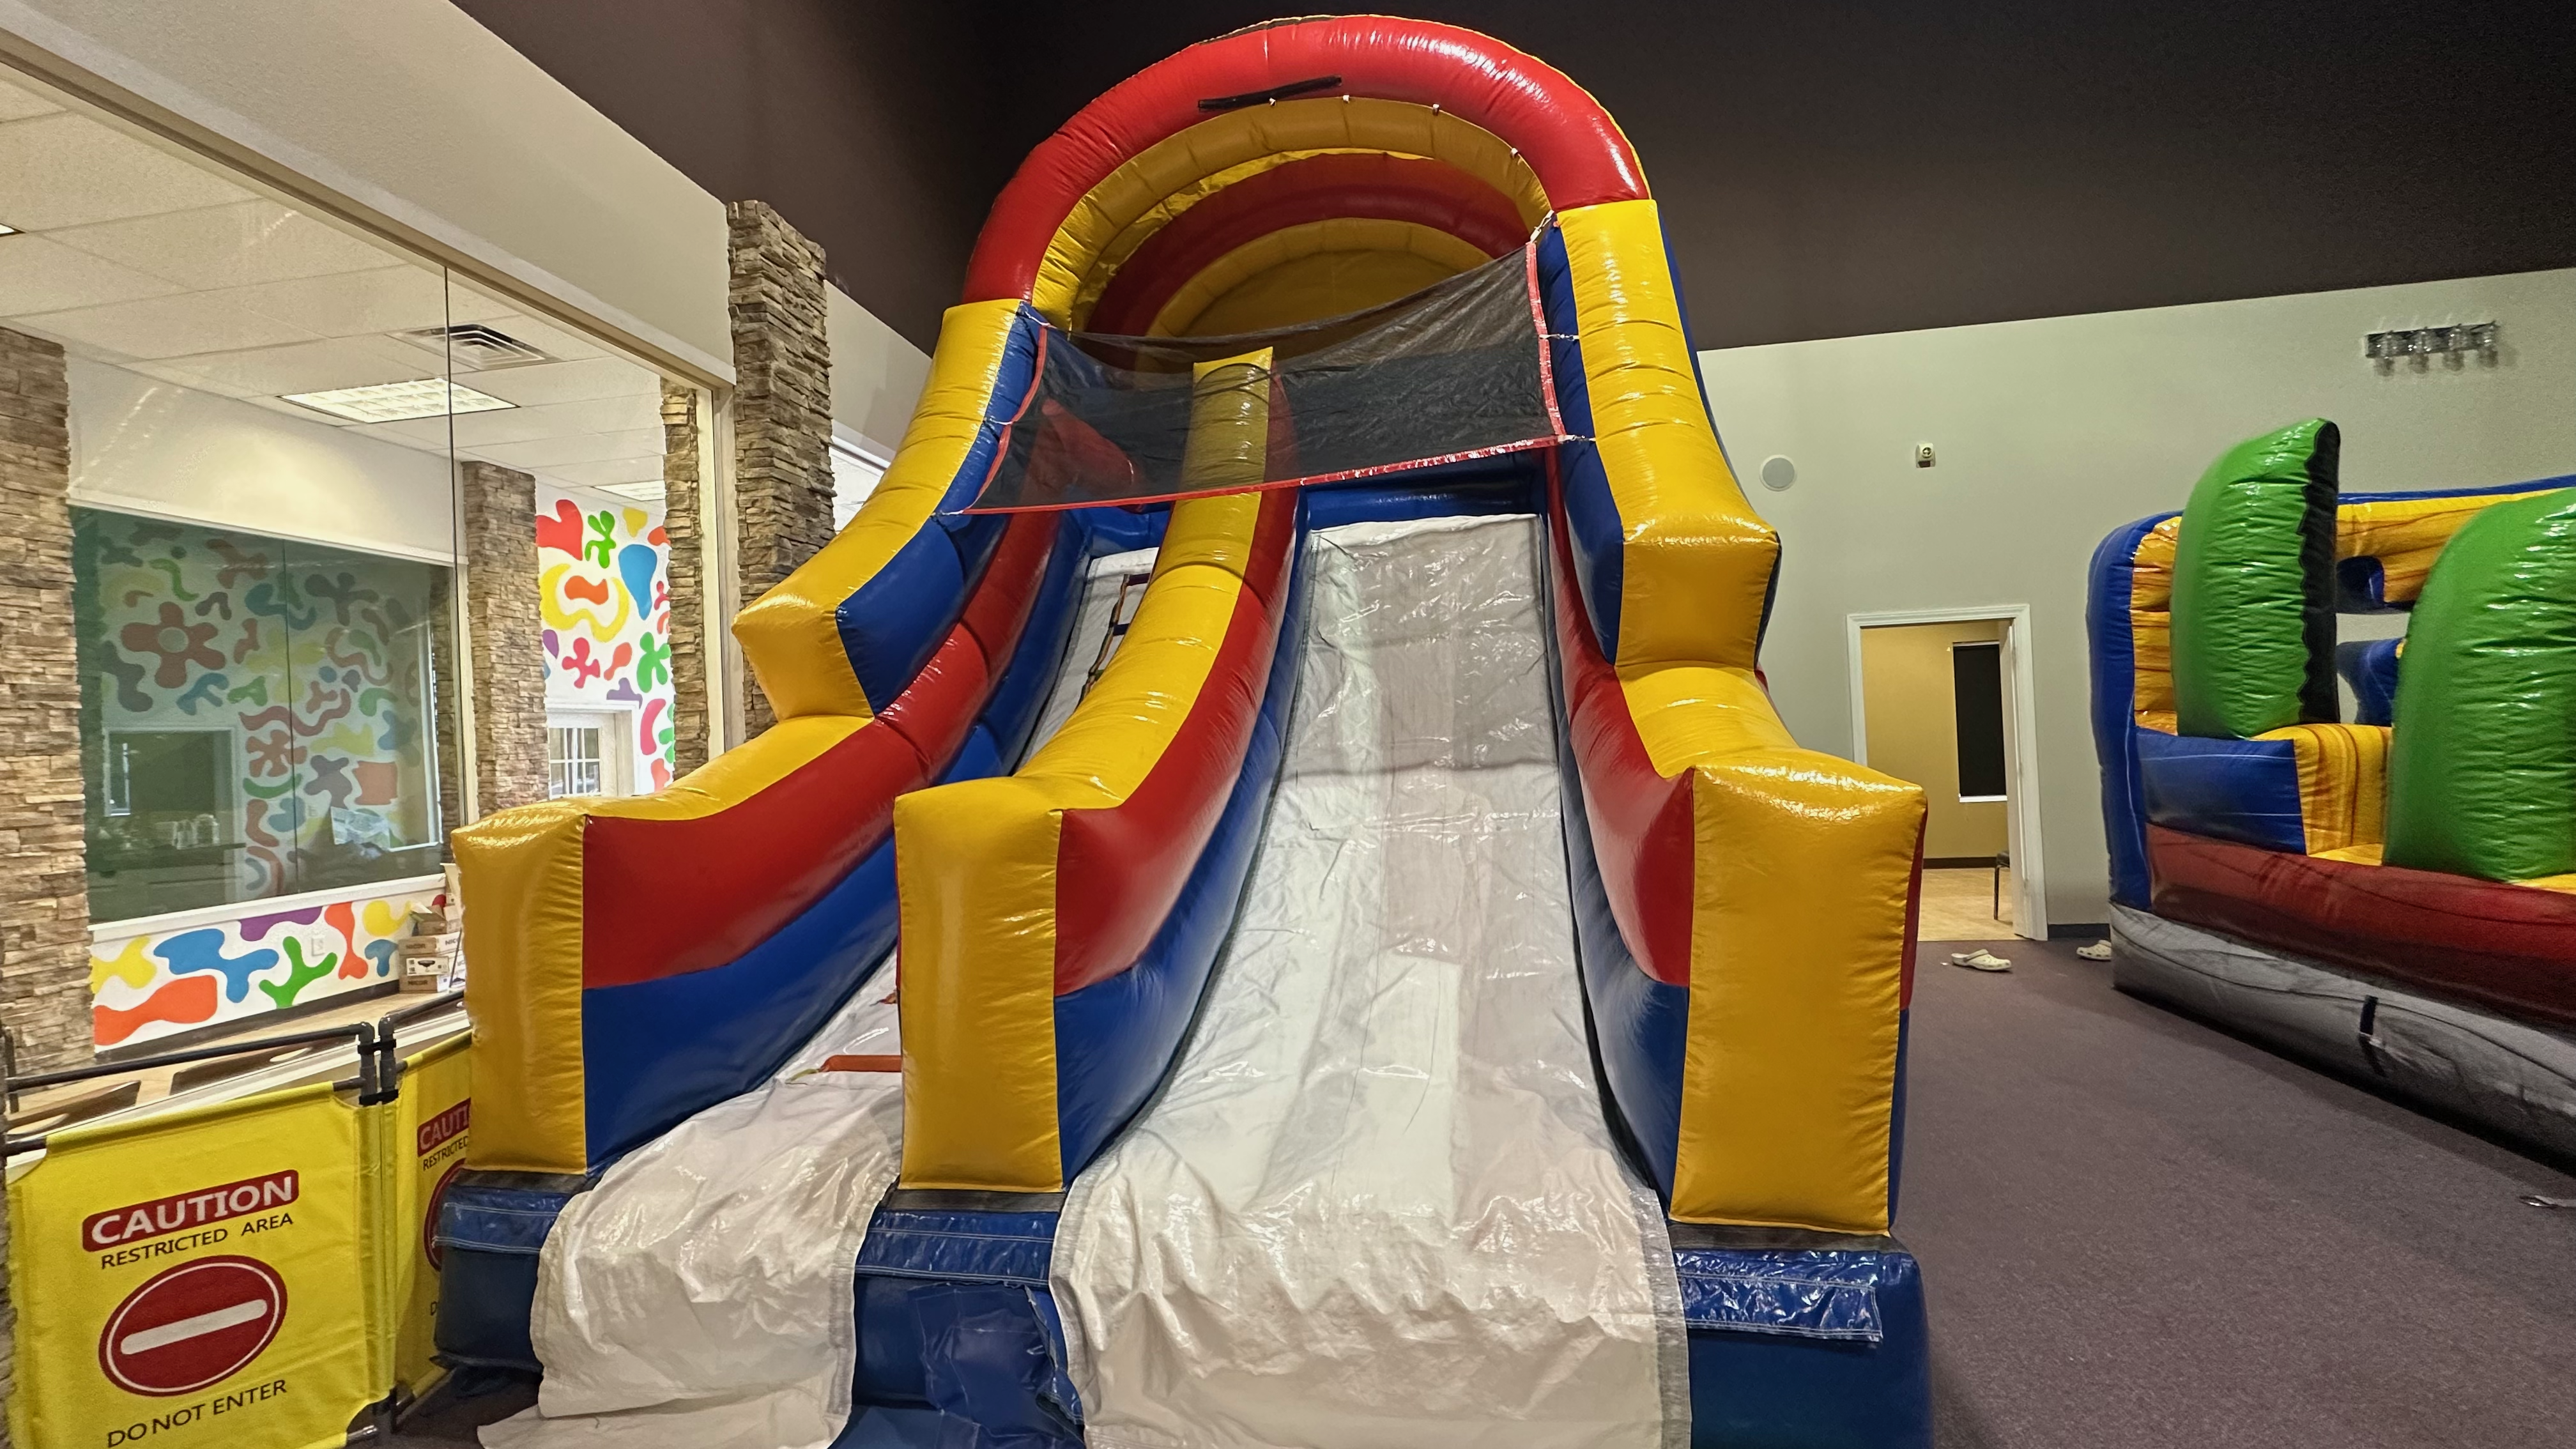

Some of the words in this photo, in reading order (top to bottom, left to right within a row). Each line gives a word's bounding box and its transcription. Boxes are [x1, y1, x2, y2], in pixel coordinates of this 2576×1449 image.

[420, 1104, 468, 1151] CAUTI
[91, 1176, 292, 1245] CAUTION
[101, 1229, 228, 1269] RESTRICTED
[241, 1213, 293, 1236] AREA
[107, 1423, 147, 1448] DO
[153, 1404, 206, 1434] NOT
[213, 1379, 287, 1415] ENTER
